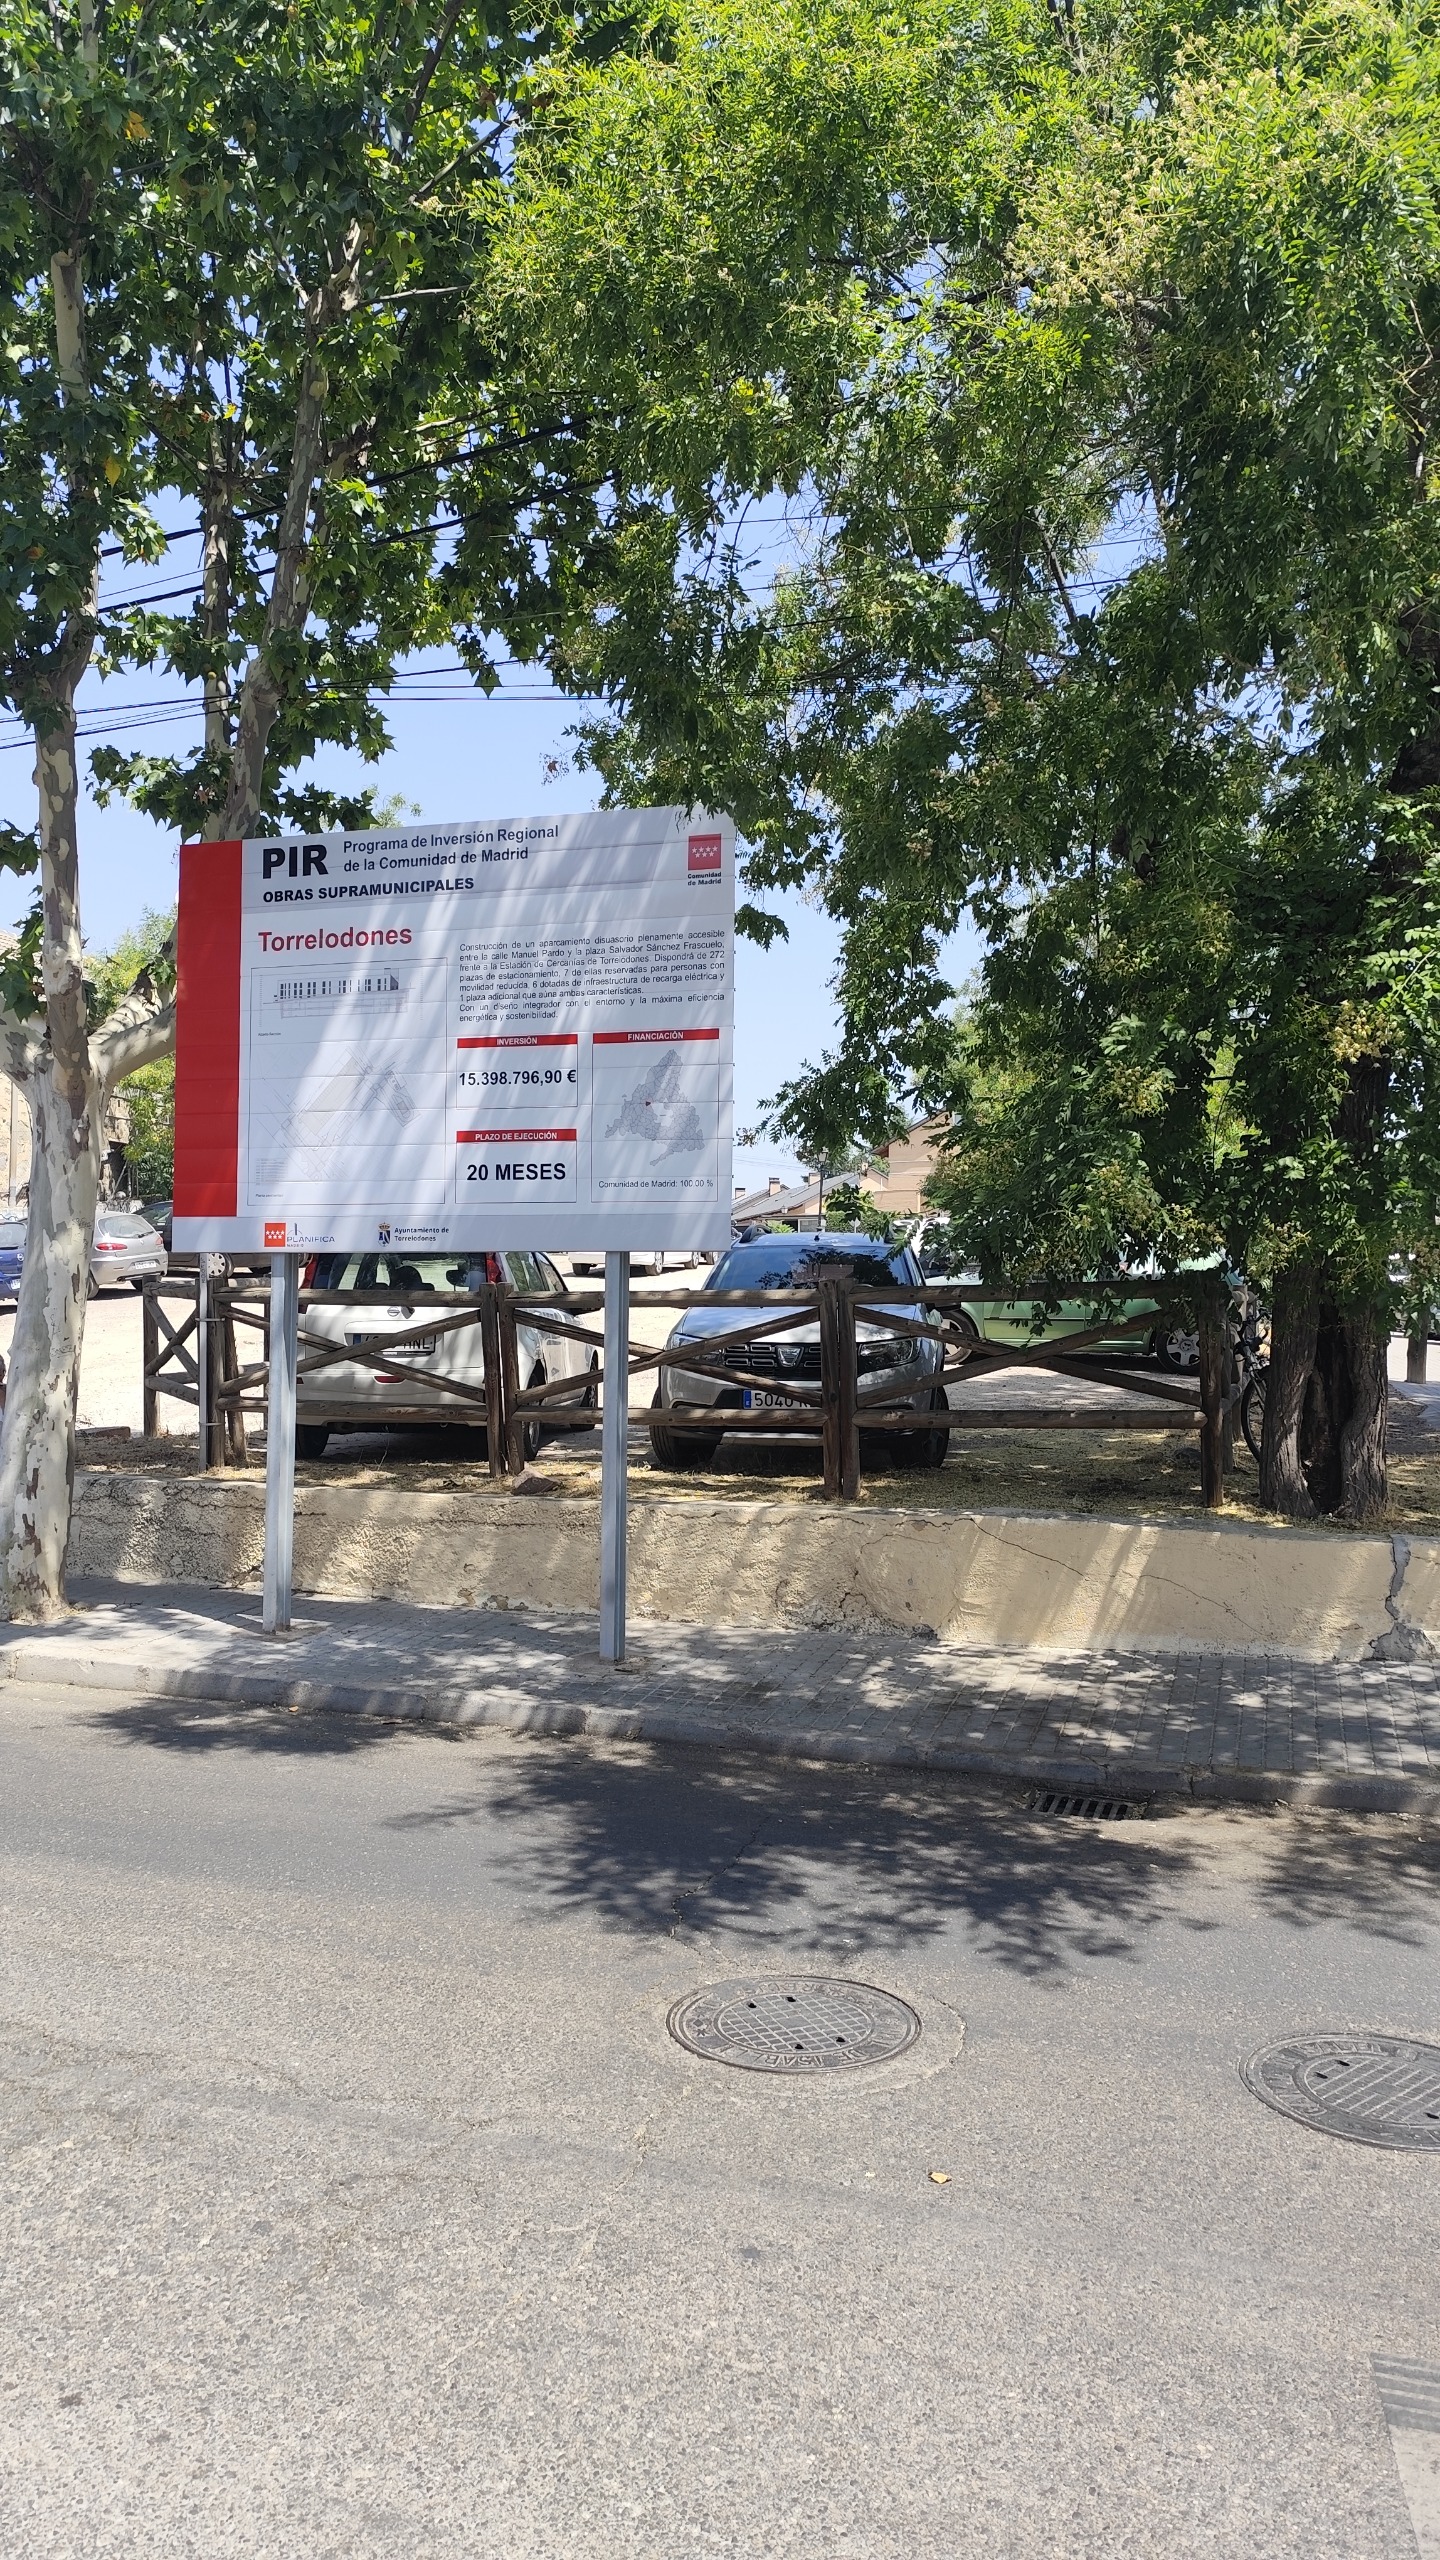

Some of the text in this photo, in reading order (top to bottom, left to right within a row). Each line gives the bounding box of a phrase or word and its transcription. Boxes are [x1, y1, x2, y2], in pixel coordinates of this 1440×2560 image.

[343, 825, 558, 855] Programa de Inversión Regional
[262, 844, 328, 879] PIR
[343, 847, 528, 872] de la Comunidad de Madrid
[687, 871, 722, 879] Comunidad
[263, 877, 475, 903] OBRAS SUPRAMUNICIPALES
[258, 926, 412, 952] Torrelodones
[460, 941, 507, 951] Construcción
[539, 937, 590, 948] aparcamiento
[594, 935, 633, 944] disuasorio
[638, 932, 683, 943] plenamente
[688, 930, 725, 939] accesible
[482, 952, 488, 960] la
[492, 952, 508, 960] calle
[512, 950, 538, 959] Manuel
[542, 949, 564, 957] Pardo
[586, 947, 605, 956] plaza
[609, 945, 643, 954] Salvador
[647, 943, 680, 952] Sánchez
[684, 941, 725, 949] Frascuelo,
[491, 962, 497, 970] la
[500, 960, 531, 970] Estación
[534, 960, 544, 968] de
[547, 958, 585, 967] Cercanías
[600, 956, 651, 965] Torrelodones.
[655, 952, 694, 962] Dispondrá
[710, 950, 725, 959] 272
[460, 974, 483, 983] plazas
[498, 970, 560, 980] estacionamiento,
[572, 968, 581, 976] de
[605, 965, 647, 974] reservadas
[650, 965, 667, 974] para
[671, 963, 707, 973] personas
[460, 983, 494, 992] movilidad
[497, 981, 529, 990] reducida,
[540, 979, 569, 988] dotadas
[584, 976, 637, 986] infraestructura
[640, 975, 650, 983] de
[653, 975, 682, 984] recarga
[685, 972, 717, 981] eléctrica
[720, 973, 725, 981] y
[460, 1004, 474, 1012] Con
[494, 1001, 518, 1010] diseño
[523, 1001, 561, 1010] integrador
[596, 998, 625, 1006] entorno
[640, 996, 647, 1004] la
[652, 995, 682, 1003] máxima
[688, 993, 725, 1002] eficiencia
[466, 994, 485, 1003] plaza
[488, 991, 520, 1000] adicional
[522, 992, 536, 1001] que
[539, 990, 556, 998] aúna
[559, 989, 584, 997] ambas
[587, 987, 644, 996] características.
[460, 1011, 558, 1022] energética y sostenibilidad.
[496, 1036, 538, 1046] INVERSIÓN
[627, 1030, 684, 1041] FINANCIACIÓN
[459, 1069, 577, 1086] 15.398.796,90 €
[475, 1133, 500, 1141] PLAZO
[514, 1130, 557, 1140] EJECUCIÓN
[467, 1162, 566, 1181] 20 MESES
[598, 1180, 639, 1188] Comunidad
[640, 1180, 649, 1188] de
[651, 1179, 678, 1188] Madrid:
[707, 1179, 714, 1187] %
[394, 1226, 440, 1235] Ayuntamiento
